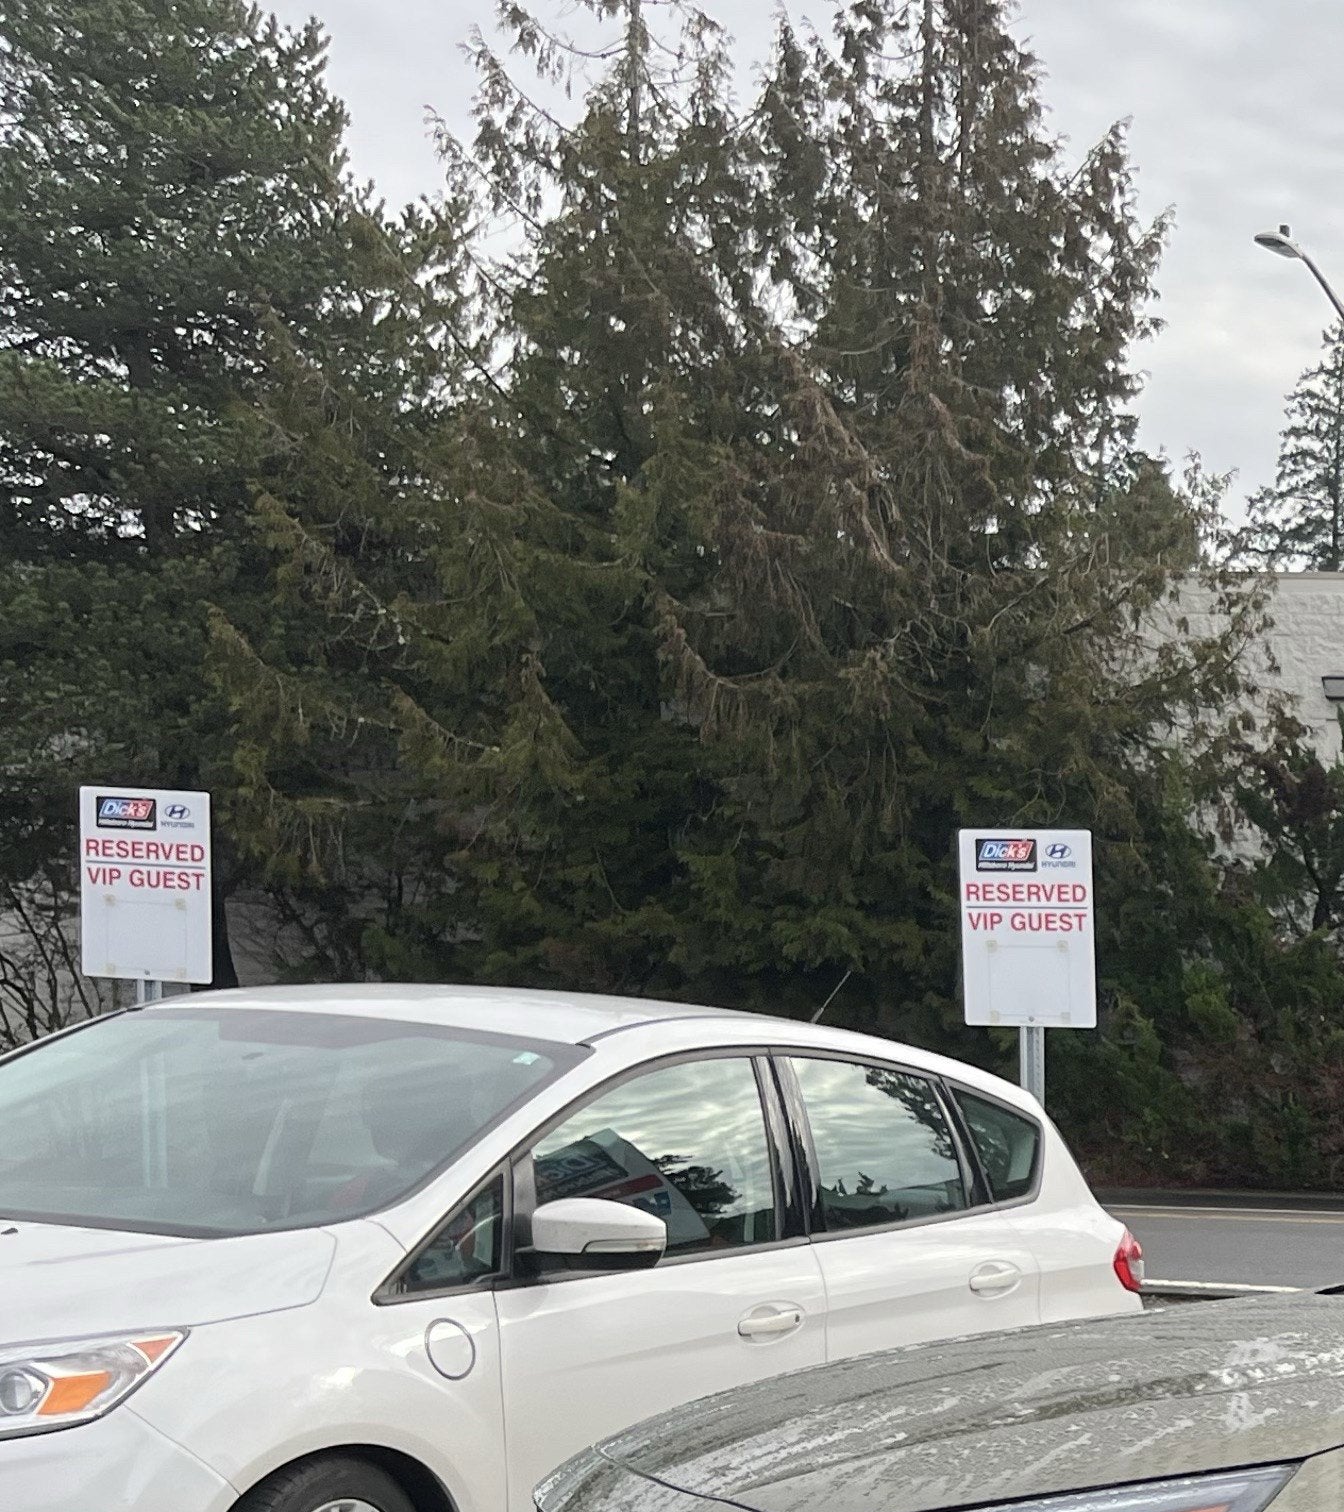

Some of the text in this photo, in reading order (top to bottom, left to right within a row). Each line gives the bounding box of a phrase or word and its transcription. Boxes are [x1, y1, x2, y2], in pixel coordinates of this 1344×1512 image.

[86, 839, 204, 862] RESERVED
[87, 867, 204, 890] VIP GUEST
[966, 883, 1087, 902] RESERVED
[968, 912, 1087, 932] VIP GUEST
